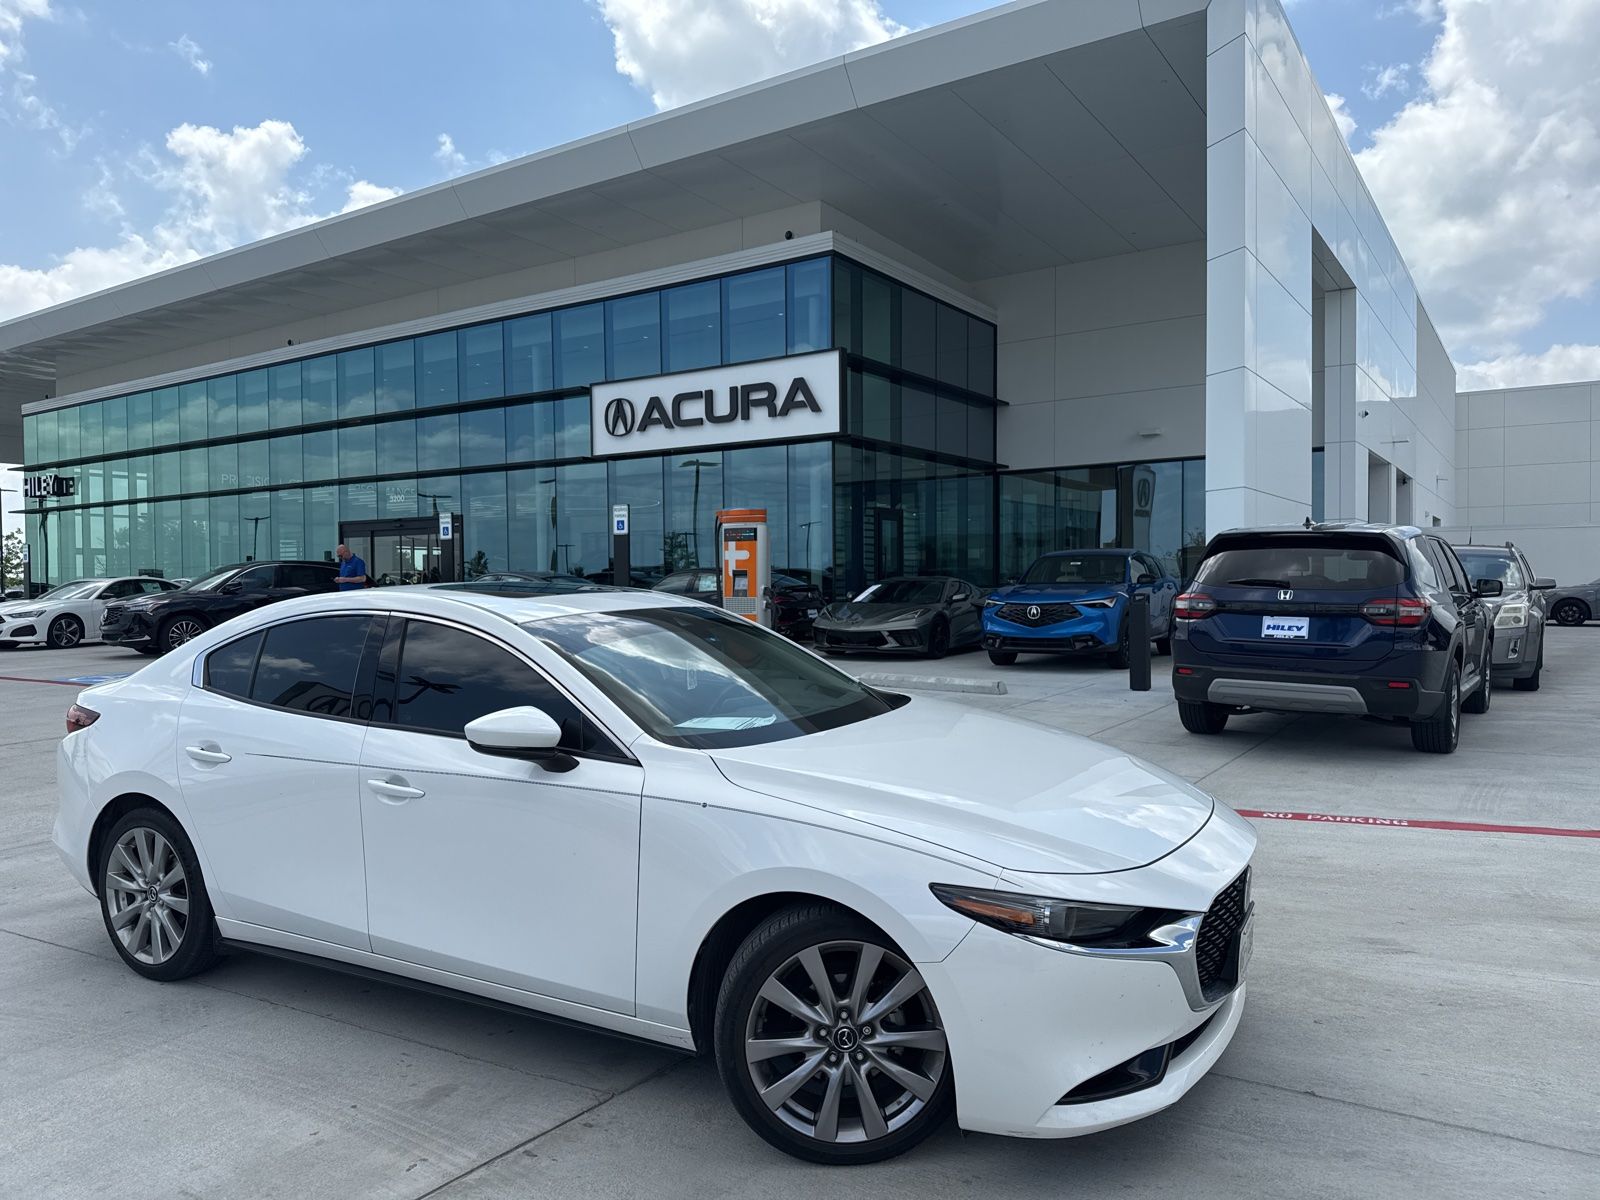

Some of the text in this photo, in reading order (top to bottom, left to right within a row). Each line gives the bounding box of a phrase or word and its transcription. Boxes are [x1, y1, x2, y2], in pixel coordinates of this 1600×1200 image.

[636, 376, 823, 433] ACURA
[23, 472, 55, 497] HILEY
[1265, 624, 1305, 632] HILEY
[1263, 811, 1409, 826] NO PARKING
